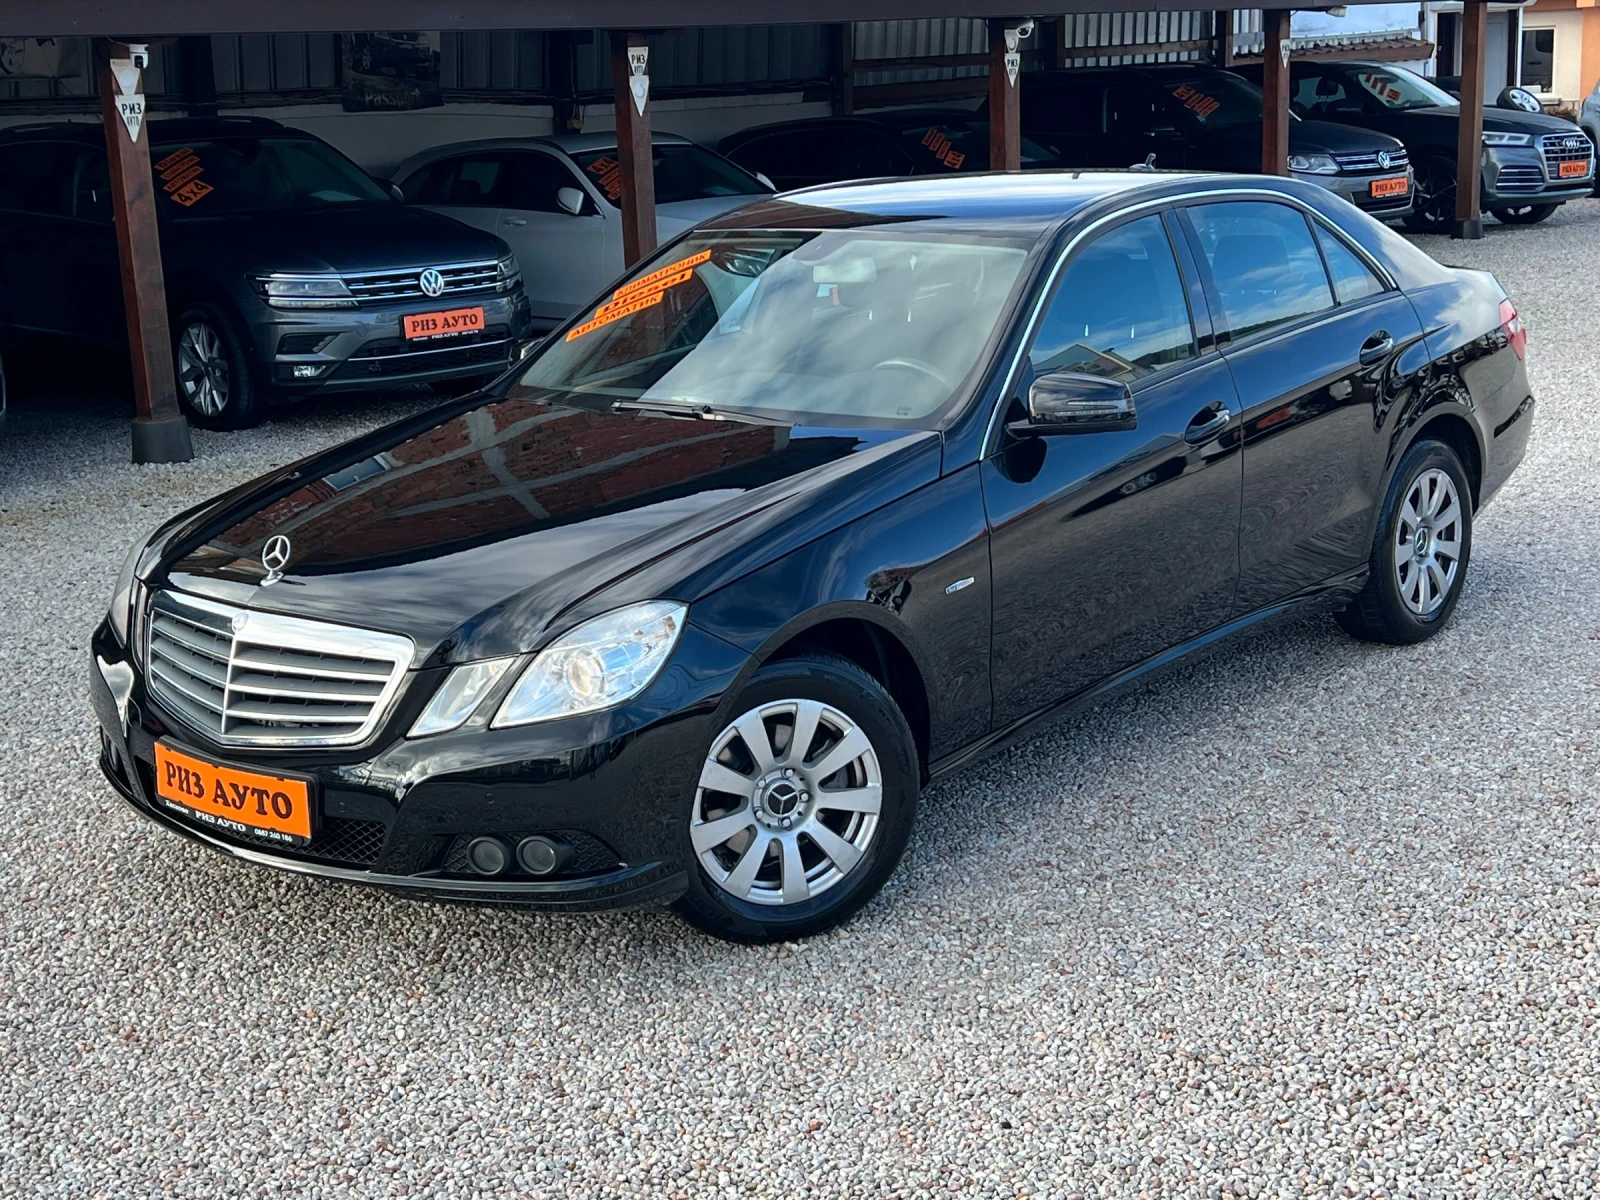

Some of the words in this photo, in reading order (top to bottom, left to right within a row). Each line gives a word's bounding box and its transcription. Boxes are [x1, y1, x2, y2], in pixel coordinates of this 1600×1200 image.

[632, 54, 646, 64] РИЗ
[121, 102, 142, 116] РИЗ
[616, 254, 706, 296] КЛИМАТРОНИК
[412, 318, 438, 332] РИЗ
[442, 314, 478, 329] АУТО
[571, 296, 658, 337] АВТОМАТИК
[164, 760, 204, 798] РИЗ
[212, 778, 293, 820] АУТО
[195, 810, 216, 824] РИЗ
[216, 818, 246, 832] АУТО
